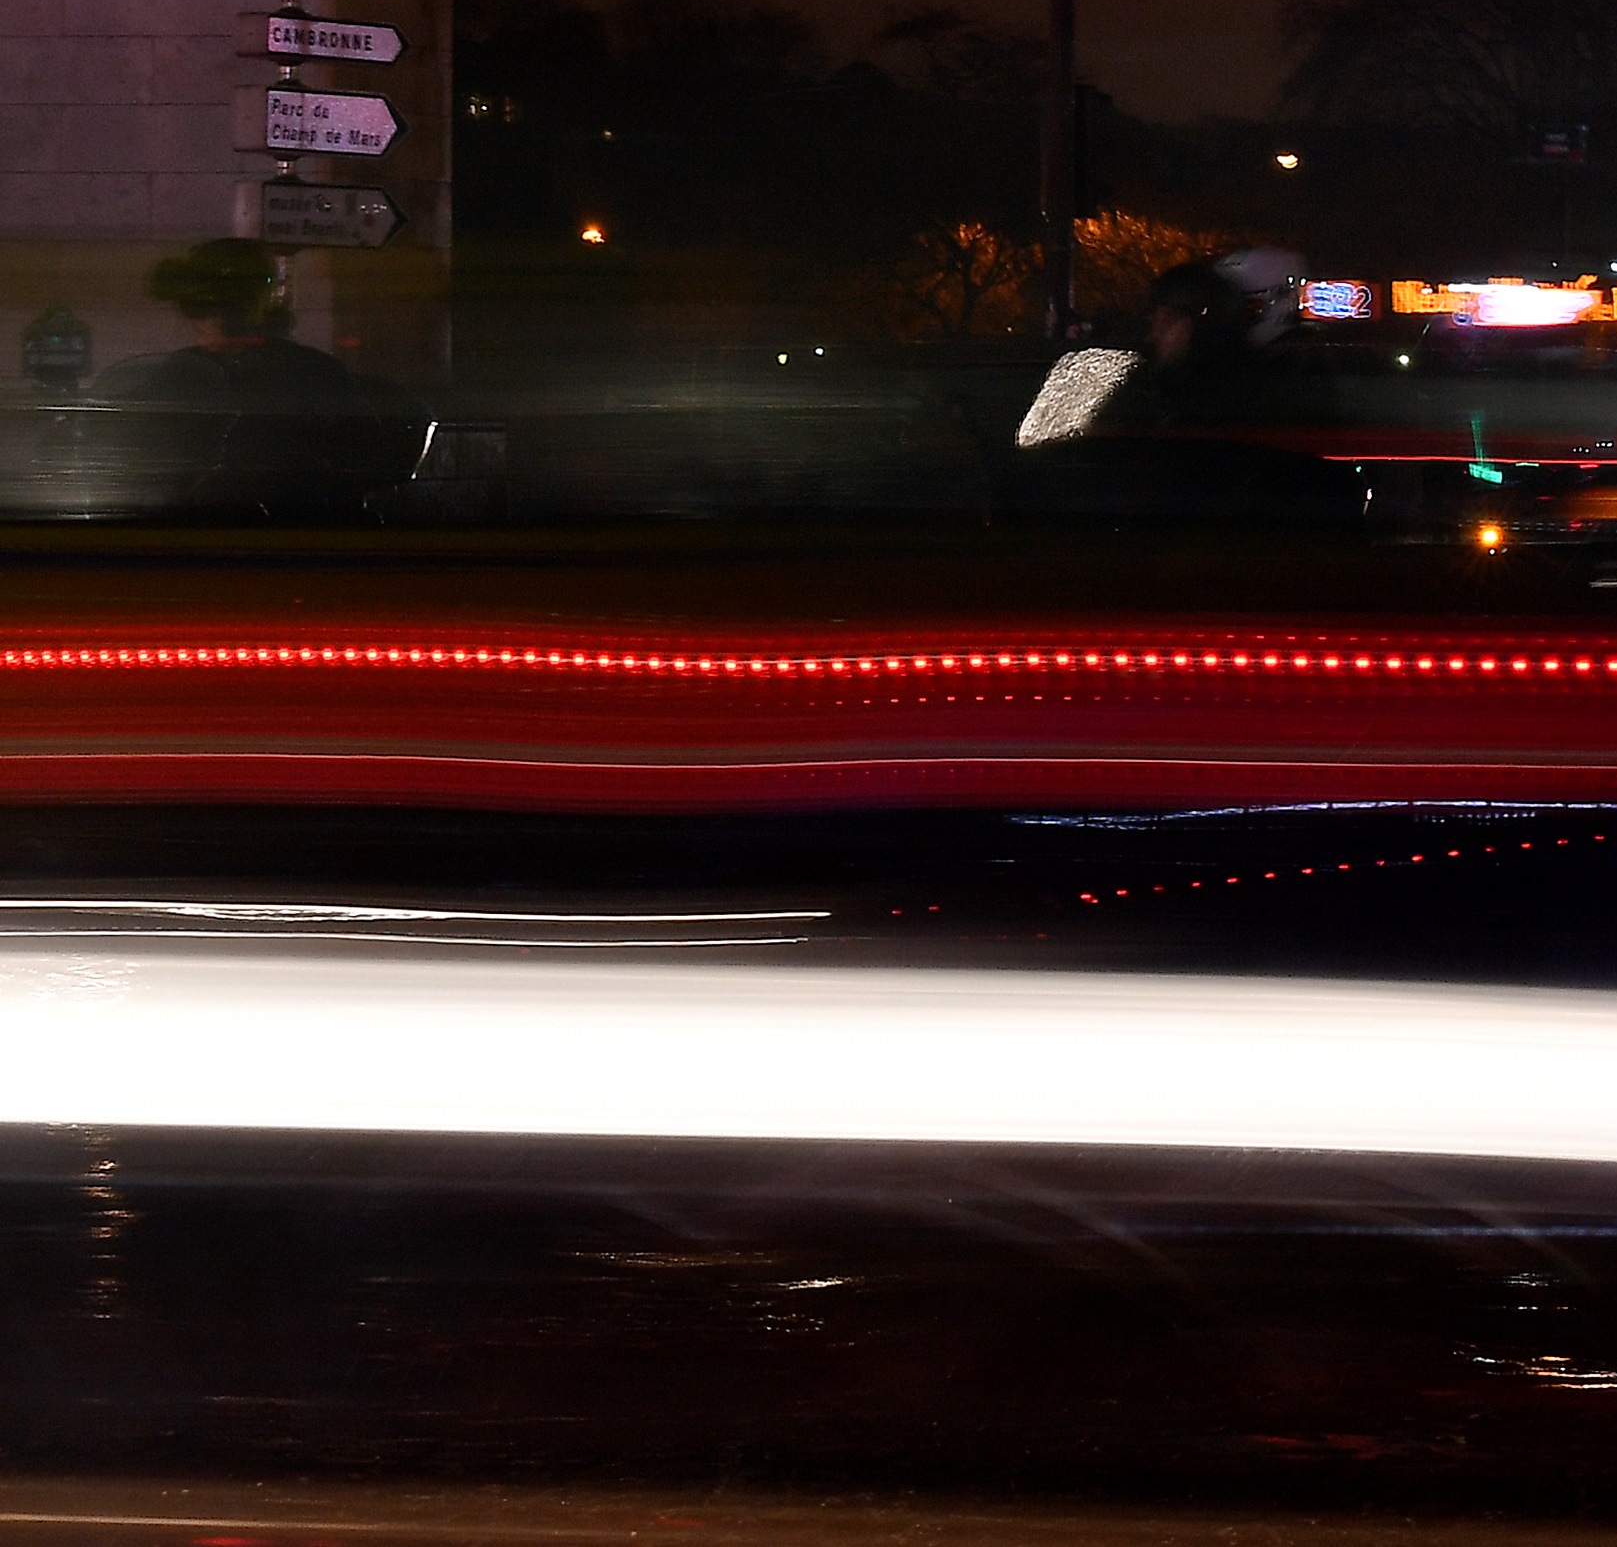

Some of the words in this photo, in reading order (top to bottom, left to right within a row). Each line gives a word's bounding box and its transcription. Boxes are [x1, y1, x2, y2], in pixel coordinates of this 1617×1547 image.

[273, 27, 373, 52] CAMBRONNE
[272, 123, 318, 145] Champ
[348, 130, 381, 147] Mars
